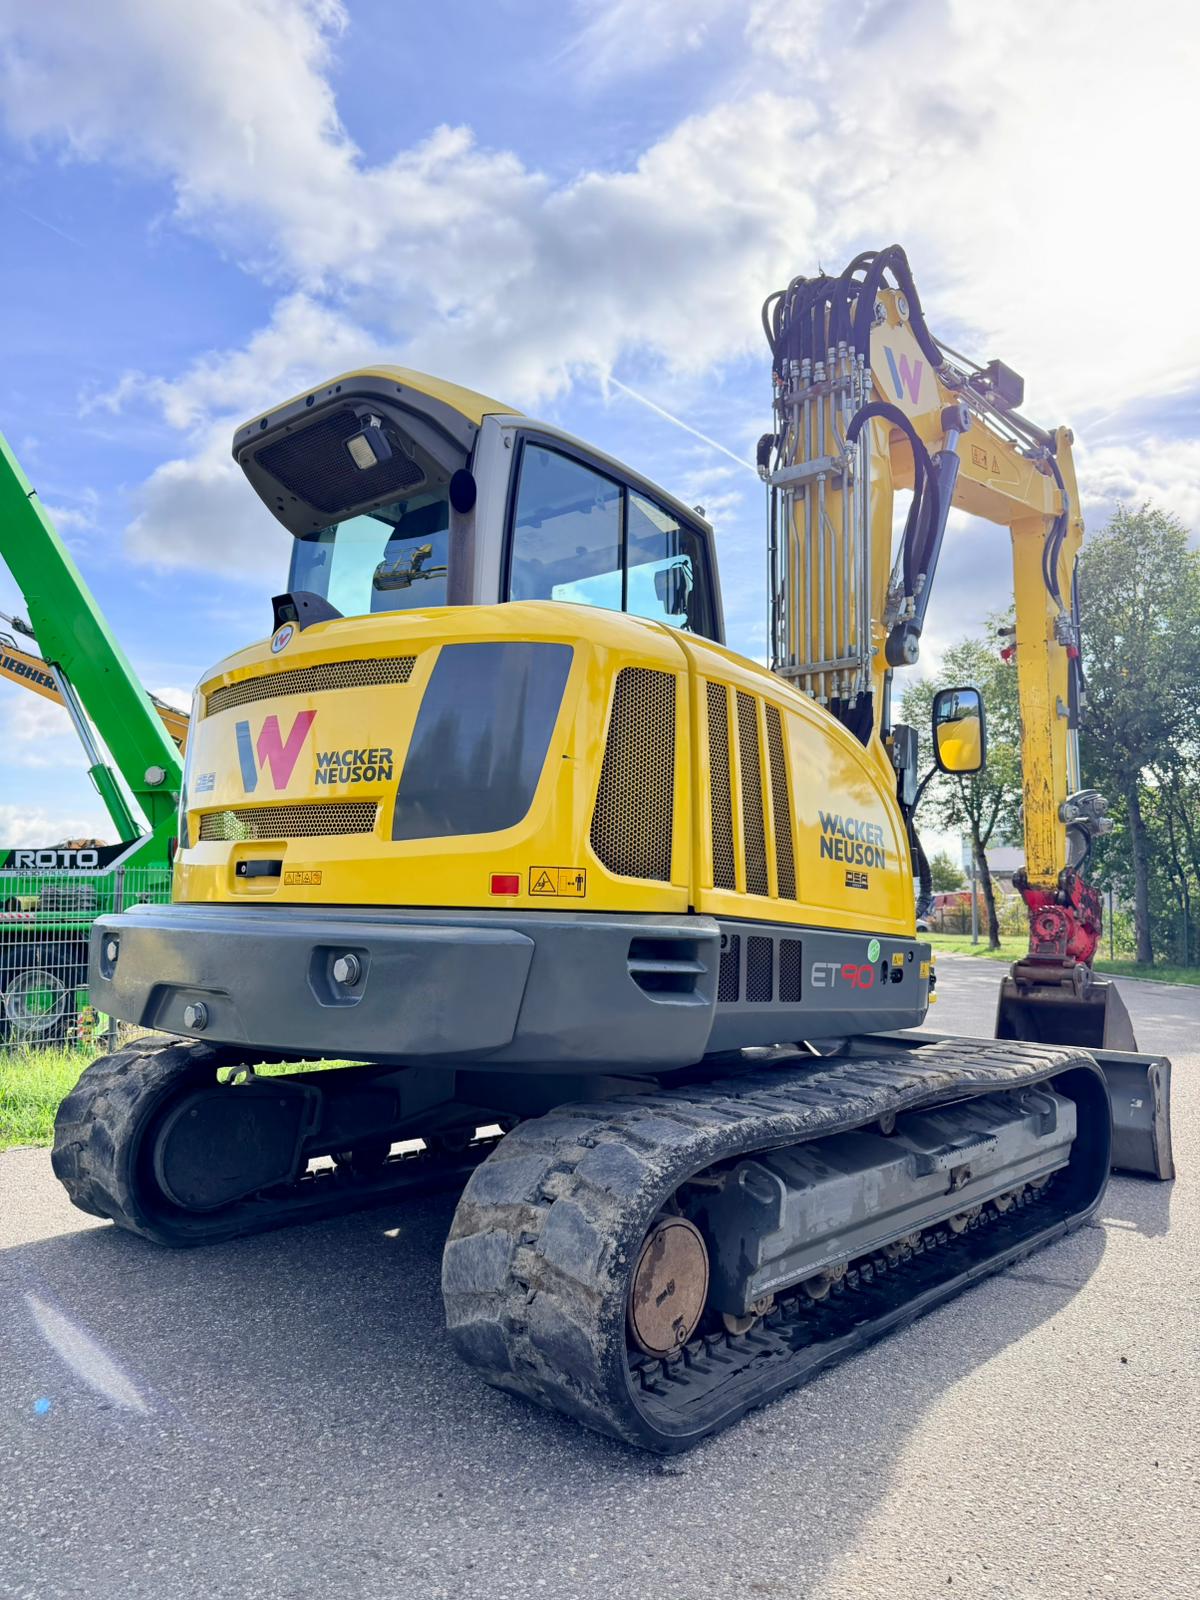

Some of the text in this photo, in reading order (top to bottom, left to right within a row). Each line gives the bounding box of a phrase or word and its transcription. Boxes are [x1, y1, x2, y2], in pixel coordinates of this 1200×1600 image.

[315, 748, 394, 768] WACKER
[314, 765, 393, 785] NEUSON
[818, 810, 885, 847] WACKER
[15, 850, 98, 868] ROTO
[820, 835, 886, 870] NEUSON
[811, 962, 875, 989] ET90
